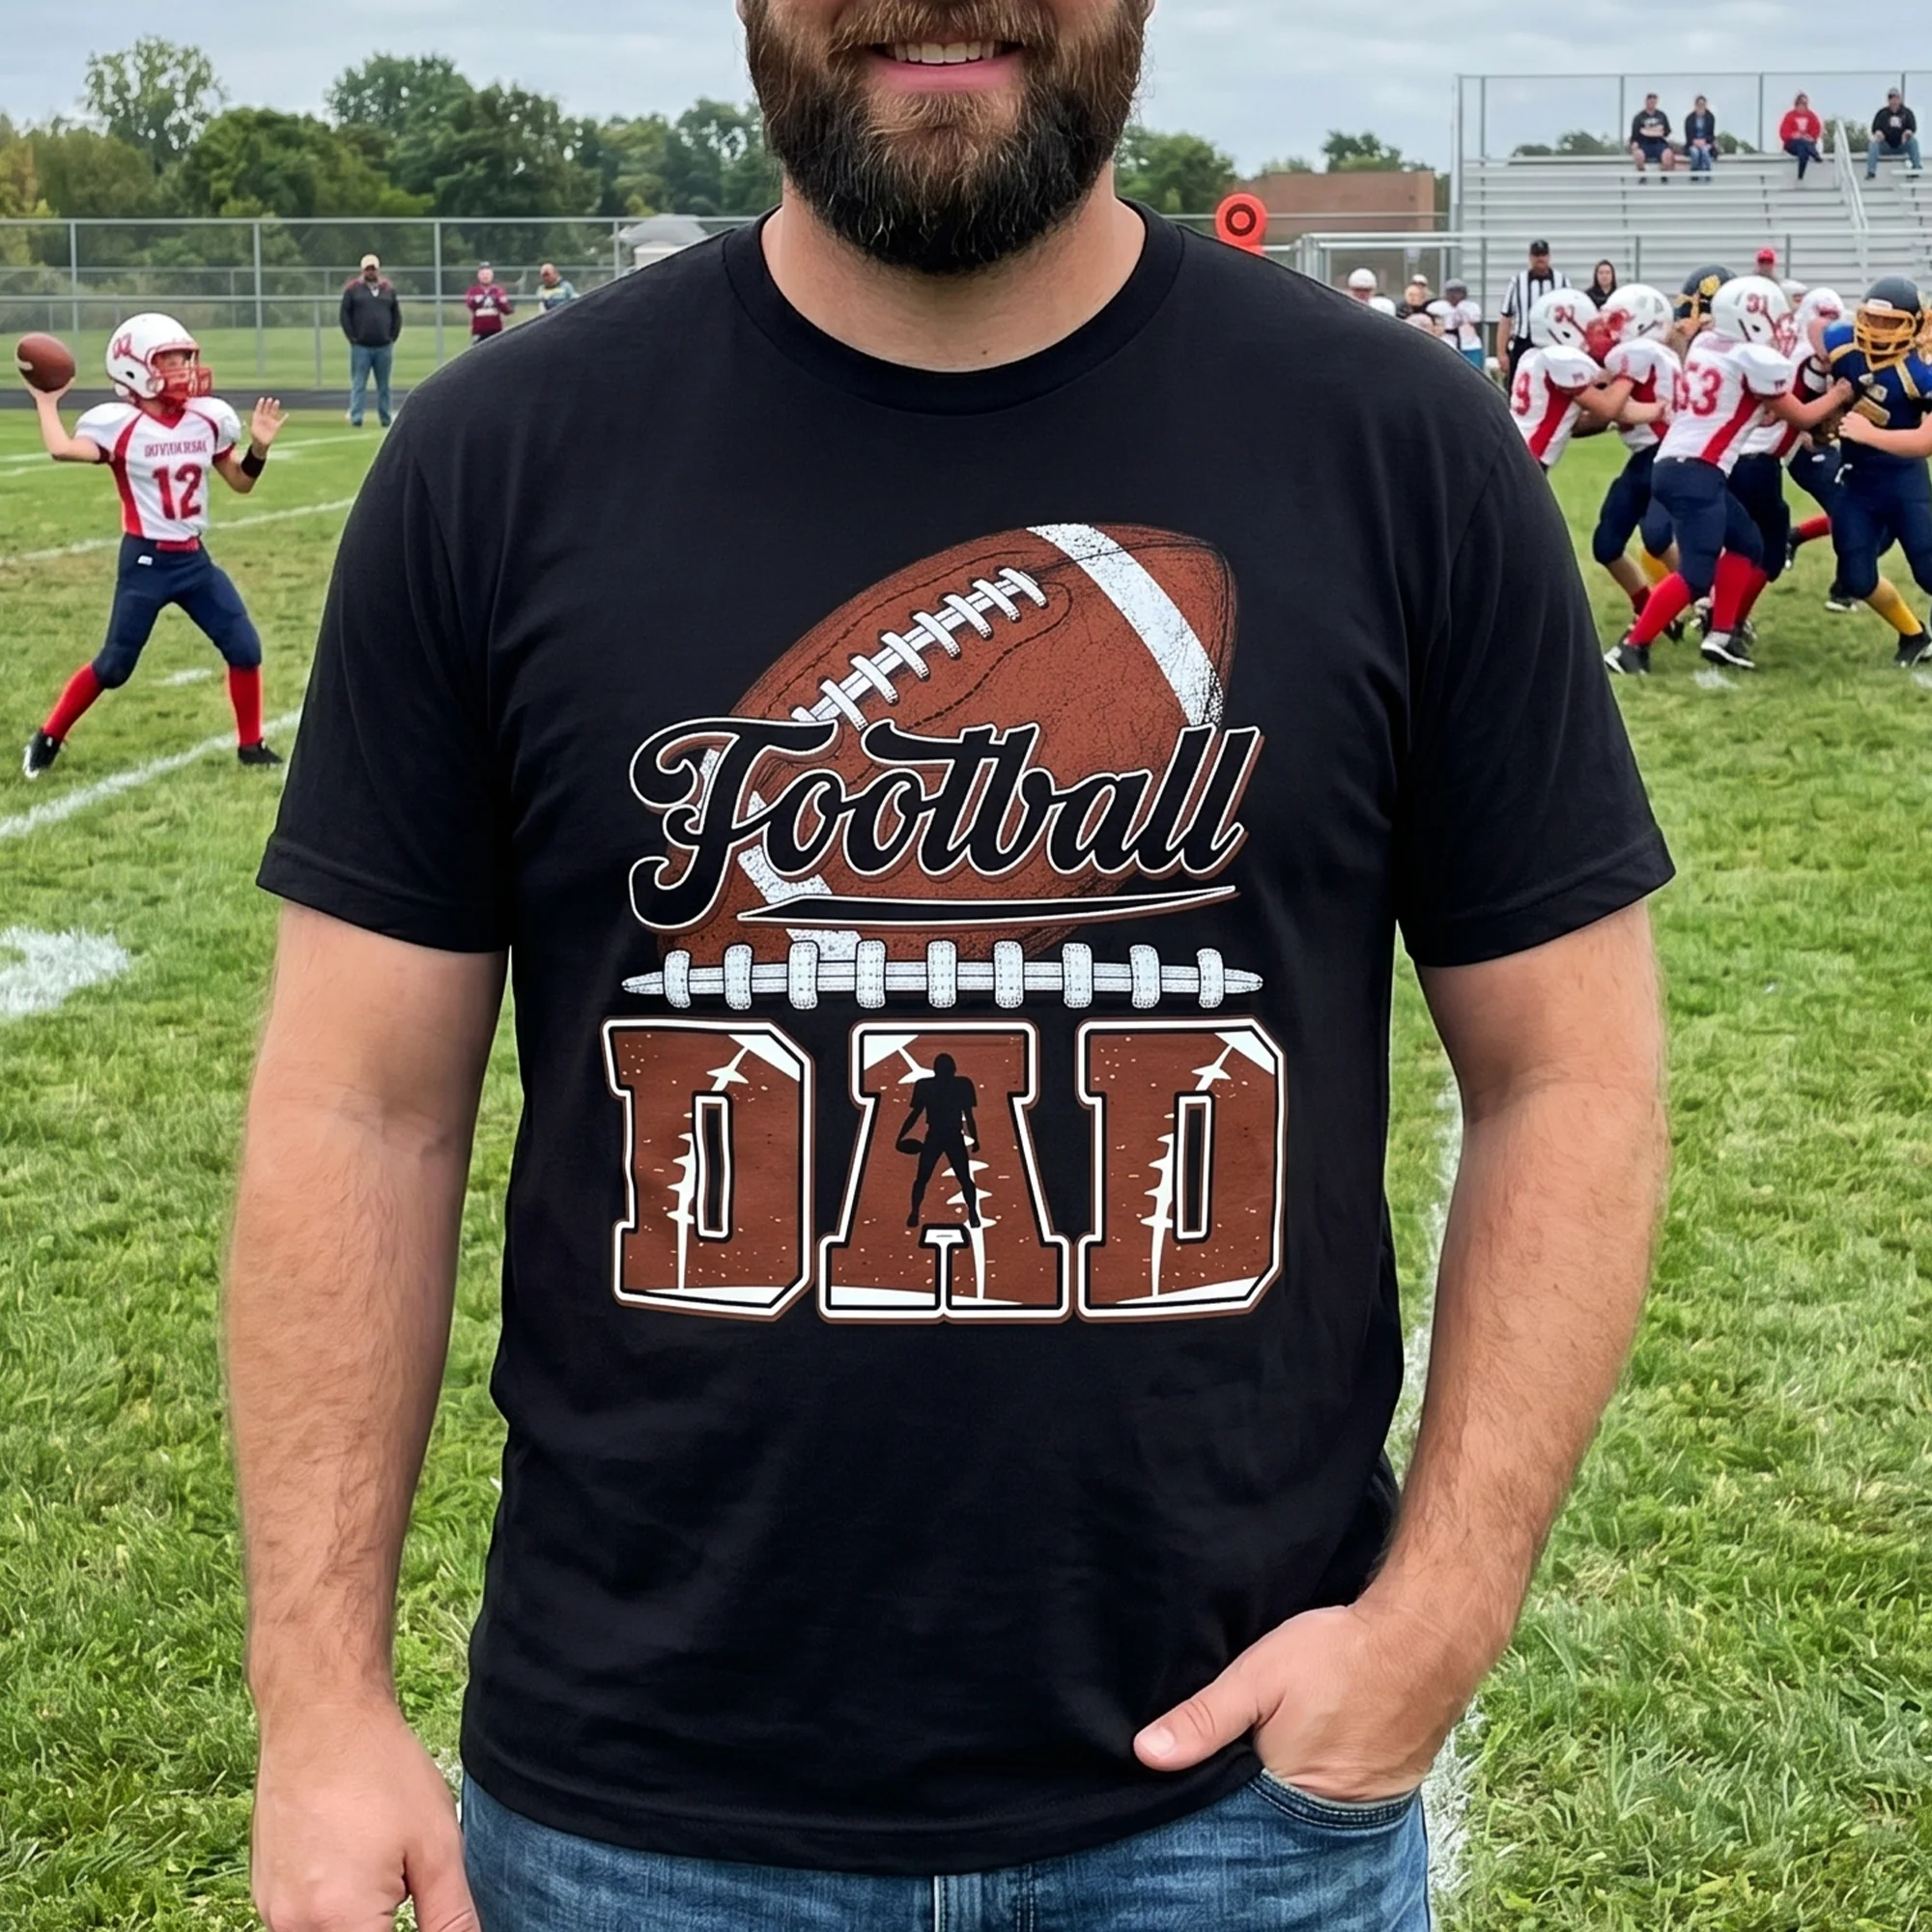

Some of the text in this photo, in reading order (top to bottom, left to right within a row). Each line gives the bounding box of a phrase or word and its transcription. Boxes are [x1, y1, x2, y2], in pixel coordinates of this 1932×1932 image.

[152, 463, 203, 520] 12
[629, 718, 1262, 927] Football
[603, 1019, 1286, 1321] DAD
